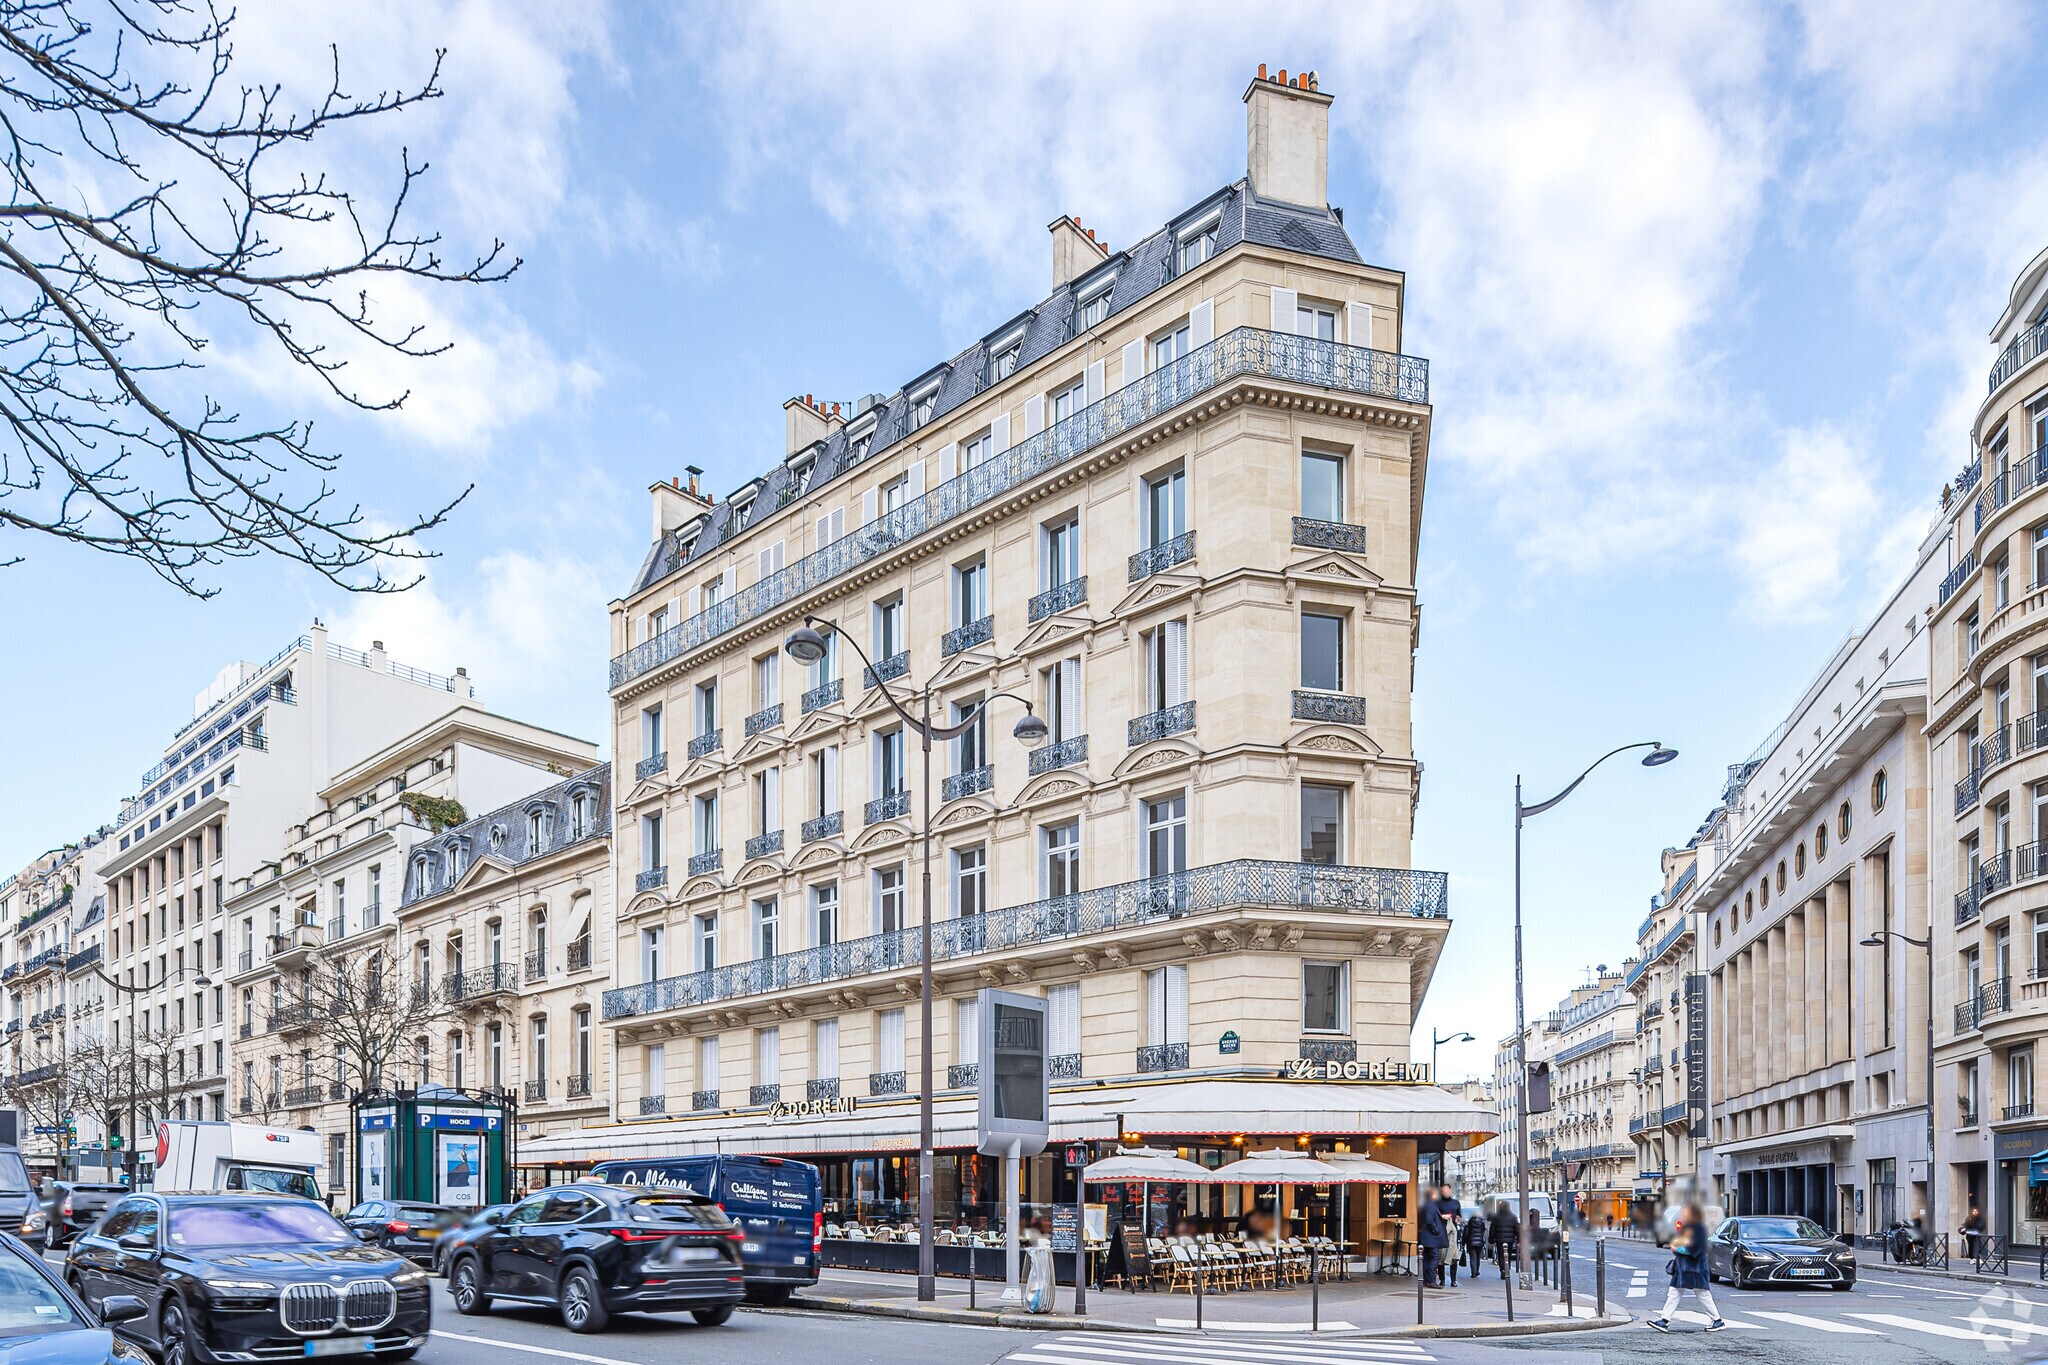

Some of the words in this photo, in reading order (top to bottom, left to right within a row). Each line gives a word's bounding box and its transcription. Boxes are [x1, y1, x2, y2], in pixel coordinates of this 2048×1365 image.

[1690, 988, 1704, 1041] PLEYEL
[1287, 1058, 1320, 1080] Le
[1326, 1060, 1361, 1080] DO
[1368, 1056, 1398, 1081] RÉ
[1405, 1062, 1431, 1082] MI
[1690, 1049, 1704, 1093] SALLE
[768, 1101, 785, 1118] Le
[788, 1101, 810, 1116] DO
[814, 1095, 833, 1115] RÉ
[837, 1096, 857, 1113] MI
[361, 1117, 367, 1129] P
[420, 1114, 431, 1127] P
[449, 1118, 471, 1126] HOCHE
[487, 1117, 498, 1130] P
[1758, 1154, 1775, 1166] SALLE
[1776, 1151, 1799, 1165] PLEYEL
[731, 1182, 768, 1199] Culligan
[772, 1179, 788, 1187] Recrute
[779, 1191, 808, 1200] Commerciaux
[779, 1201, 802, 1210] Techniciens
